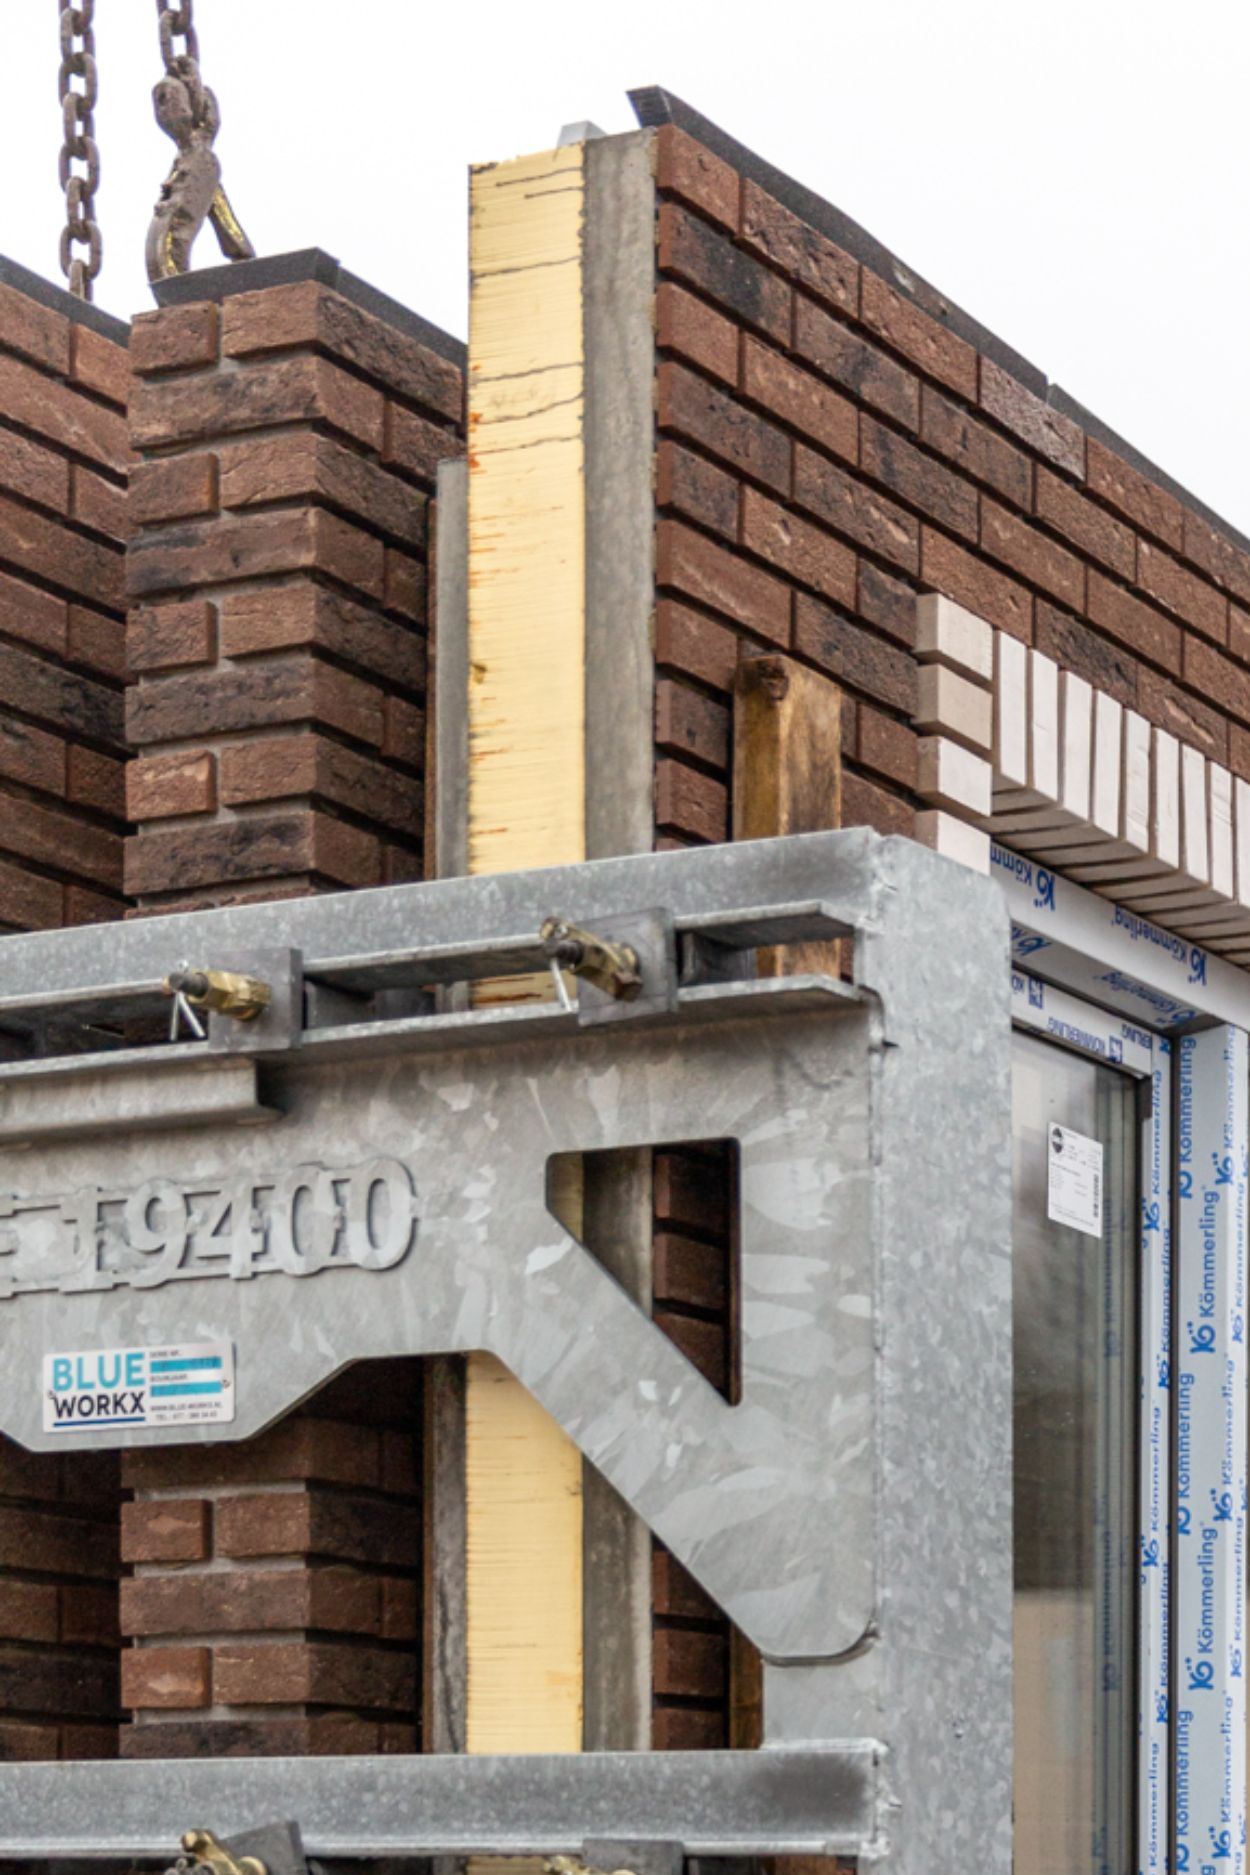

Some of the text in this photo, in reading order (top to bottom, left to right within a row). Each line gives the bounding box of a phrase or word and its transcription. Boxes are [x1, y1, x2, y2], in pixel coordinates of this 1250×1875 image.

[1113, 904, 1187, 961] Kömmerling
[1199, 1191, 1220, 1317] Kömmerling
[53, 1352, 145, 1391] BLUE
[54, 1391, 145, 1418] WORKX
[1198, 1528, 1218, 1653] Kömmerling
